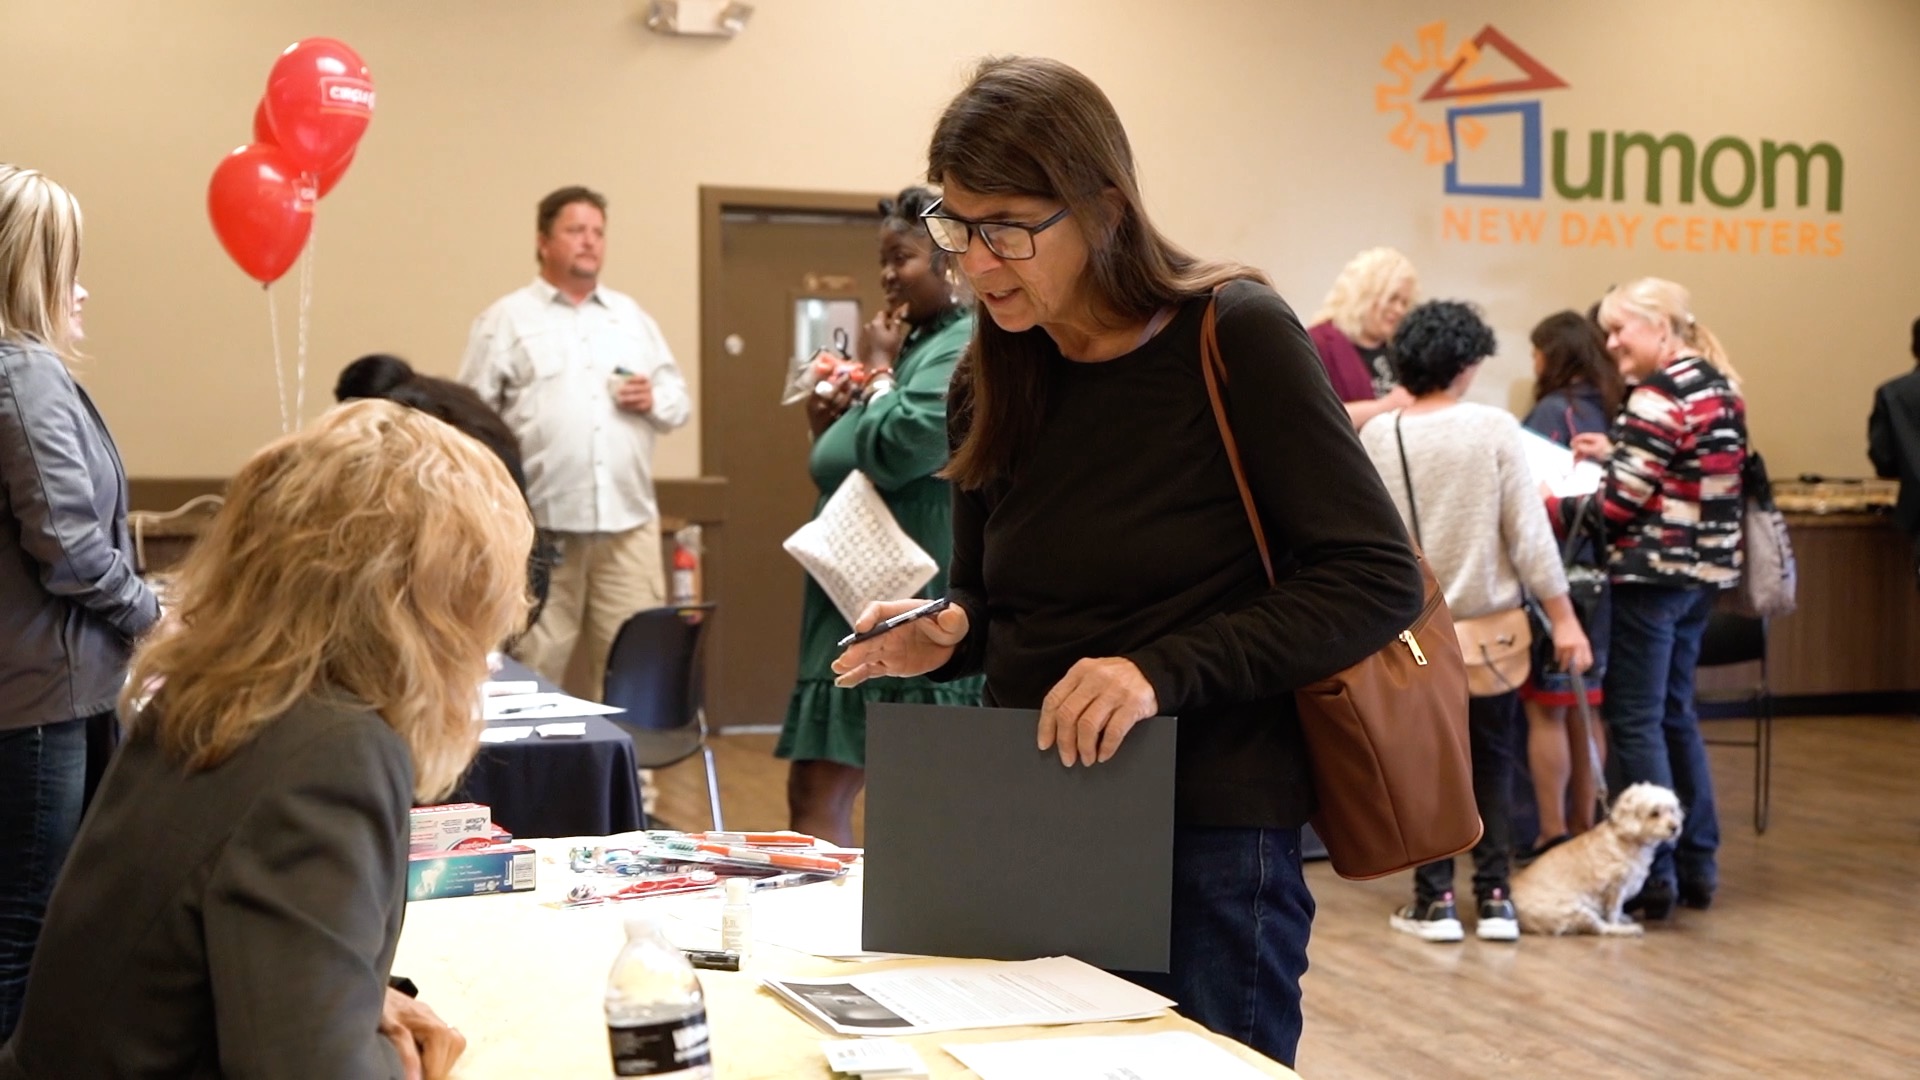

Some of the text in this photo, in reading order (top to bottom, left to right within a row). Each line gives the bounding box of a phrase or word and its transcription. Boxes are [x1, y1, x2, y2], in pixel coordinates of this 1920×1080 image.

[1551, 128, 1844, 213] umom
[1443, 207, 1845, 257] NEW DAY CENTERS
